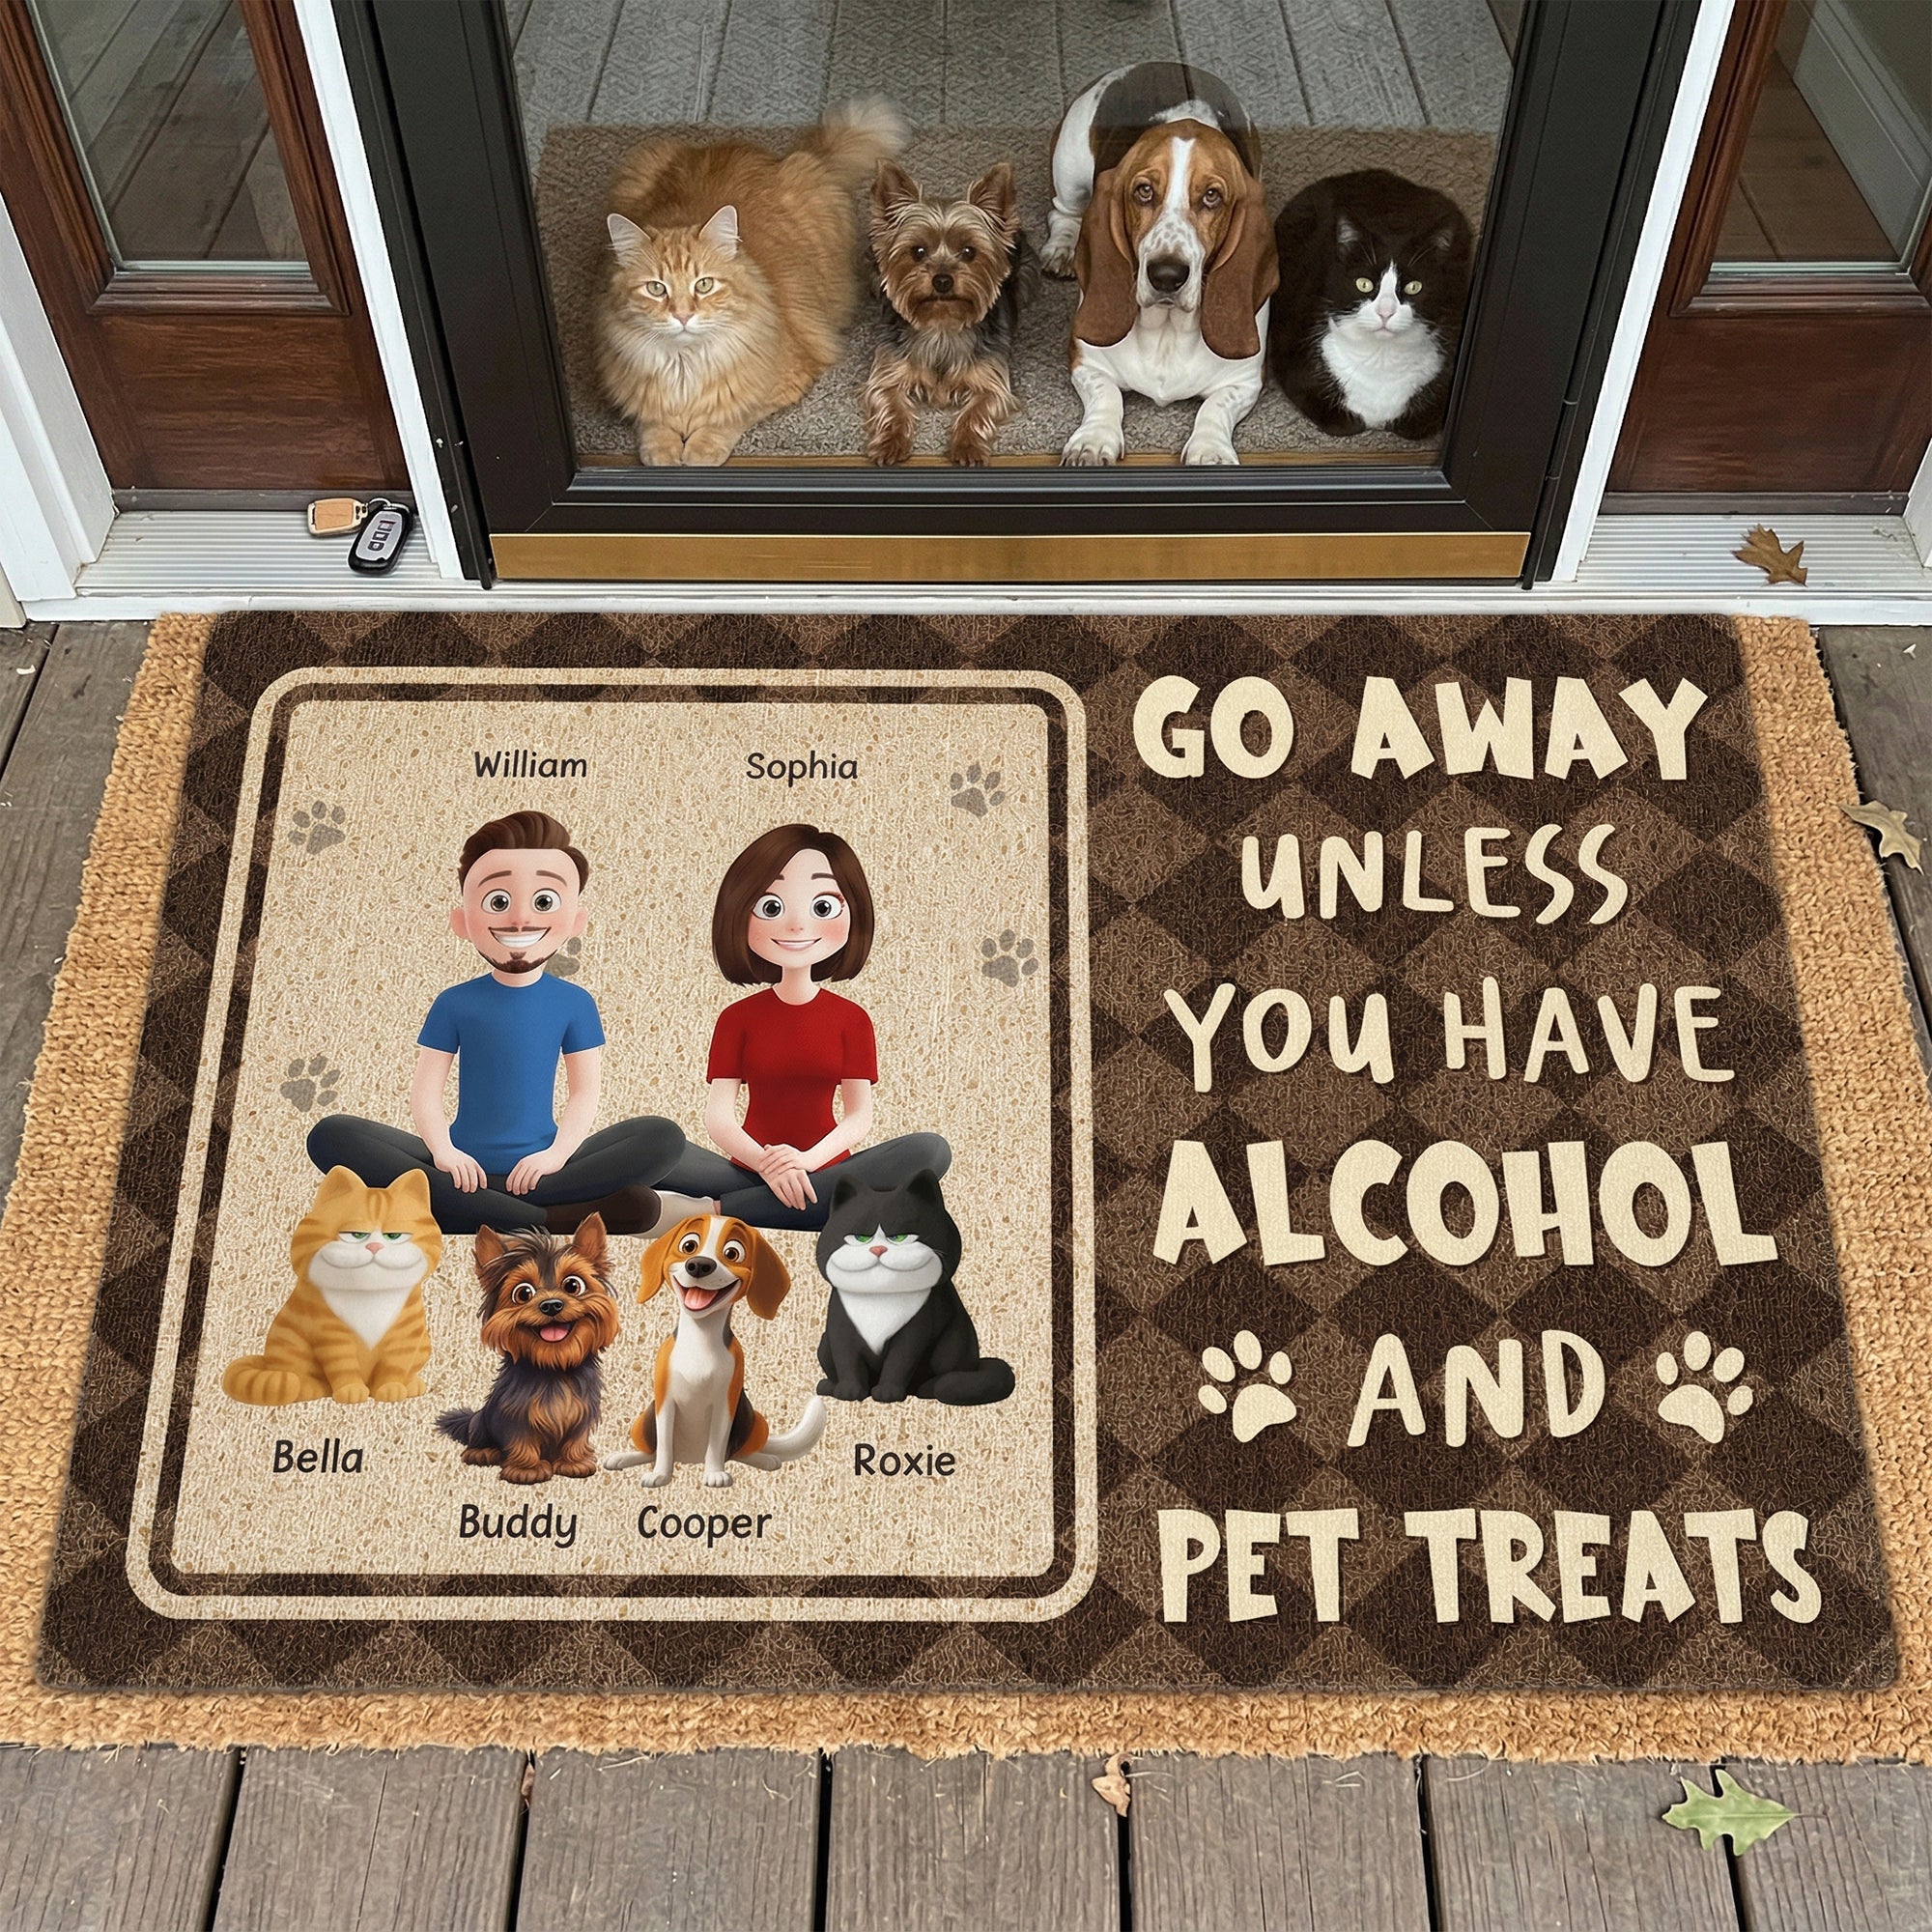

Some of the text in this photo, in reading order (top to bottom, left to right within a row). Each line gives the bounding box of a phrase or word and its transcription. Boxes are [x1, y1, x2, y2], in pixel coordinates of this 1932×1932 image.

[474, 750, 587, 778] William
[1133, 675, 1707, 780] GO AWAY
[747, 751, 857, 787] Sophia
[1241, 823, 1628, 924] UNLESS
[1163, 976, 1734, 1093] YOU HAVE
[1152, 1140, 1777, 1266] ALCOHOL
[1347, 1329, 1605, 1447] AND
[272, 1438, 363, 1473] Bella
[854, 1443, 955, 1477] Roxie
[459, 1503, 577, 1548] Buddy
[638, 1505, 772, 1548] Cooper
[1157, 1508, 1821, 1623] PET TREATS
